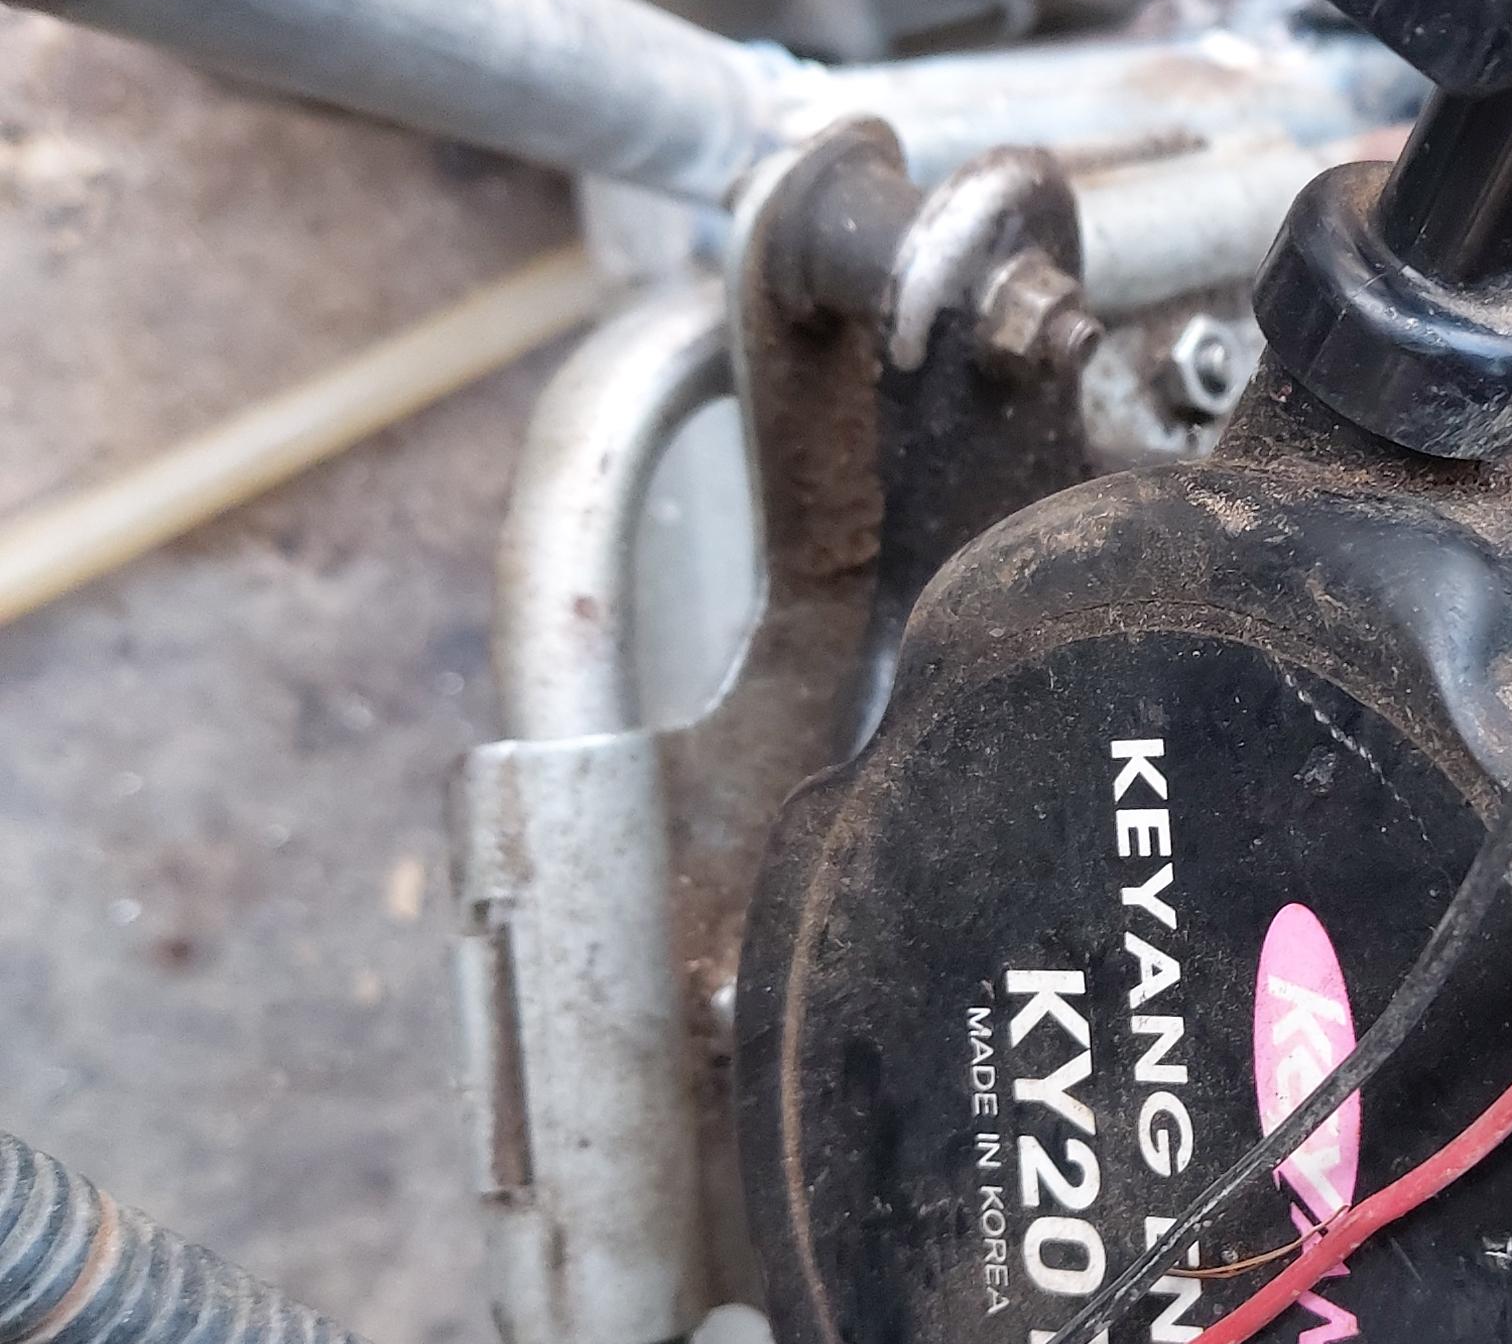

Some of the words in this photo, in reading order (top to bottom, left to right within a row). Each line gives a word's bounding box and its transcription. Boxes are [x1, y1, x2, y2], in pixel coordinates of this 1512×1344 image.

[1111, 738, 1194, 1177] KEYANG
[967, 1007, 998, 1118] MADE
[975, 1133, 1000, 1170] IN
[980, 1184, 1010, 1318] KOREA
